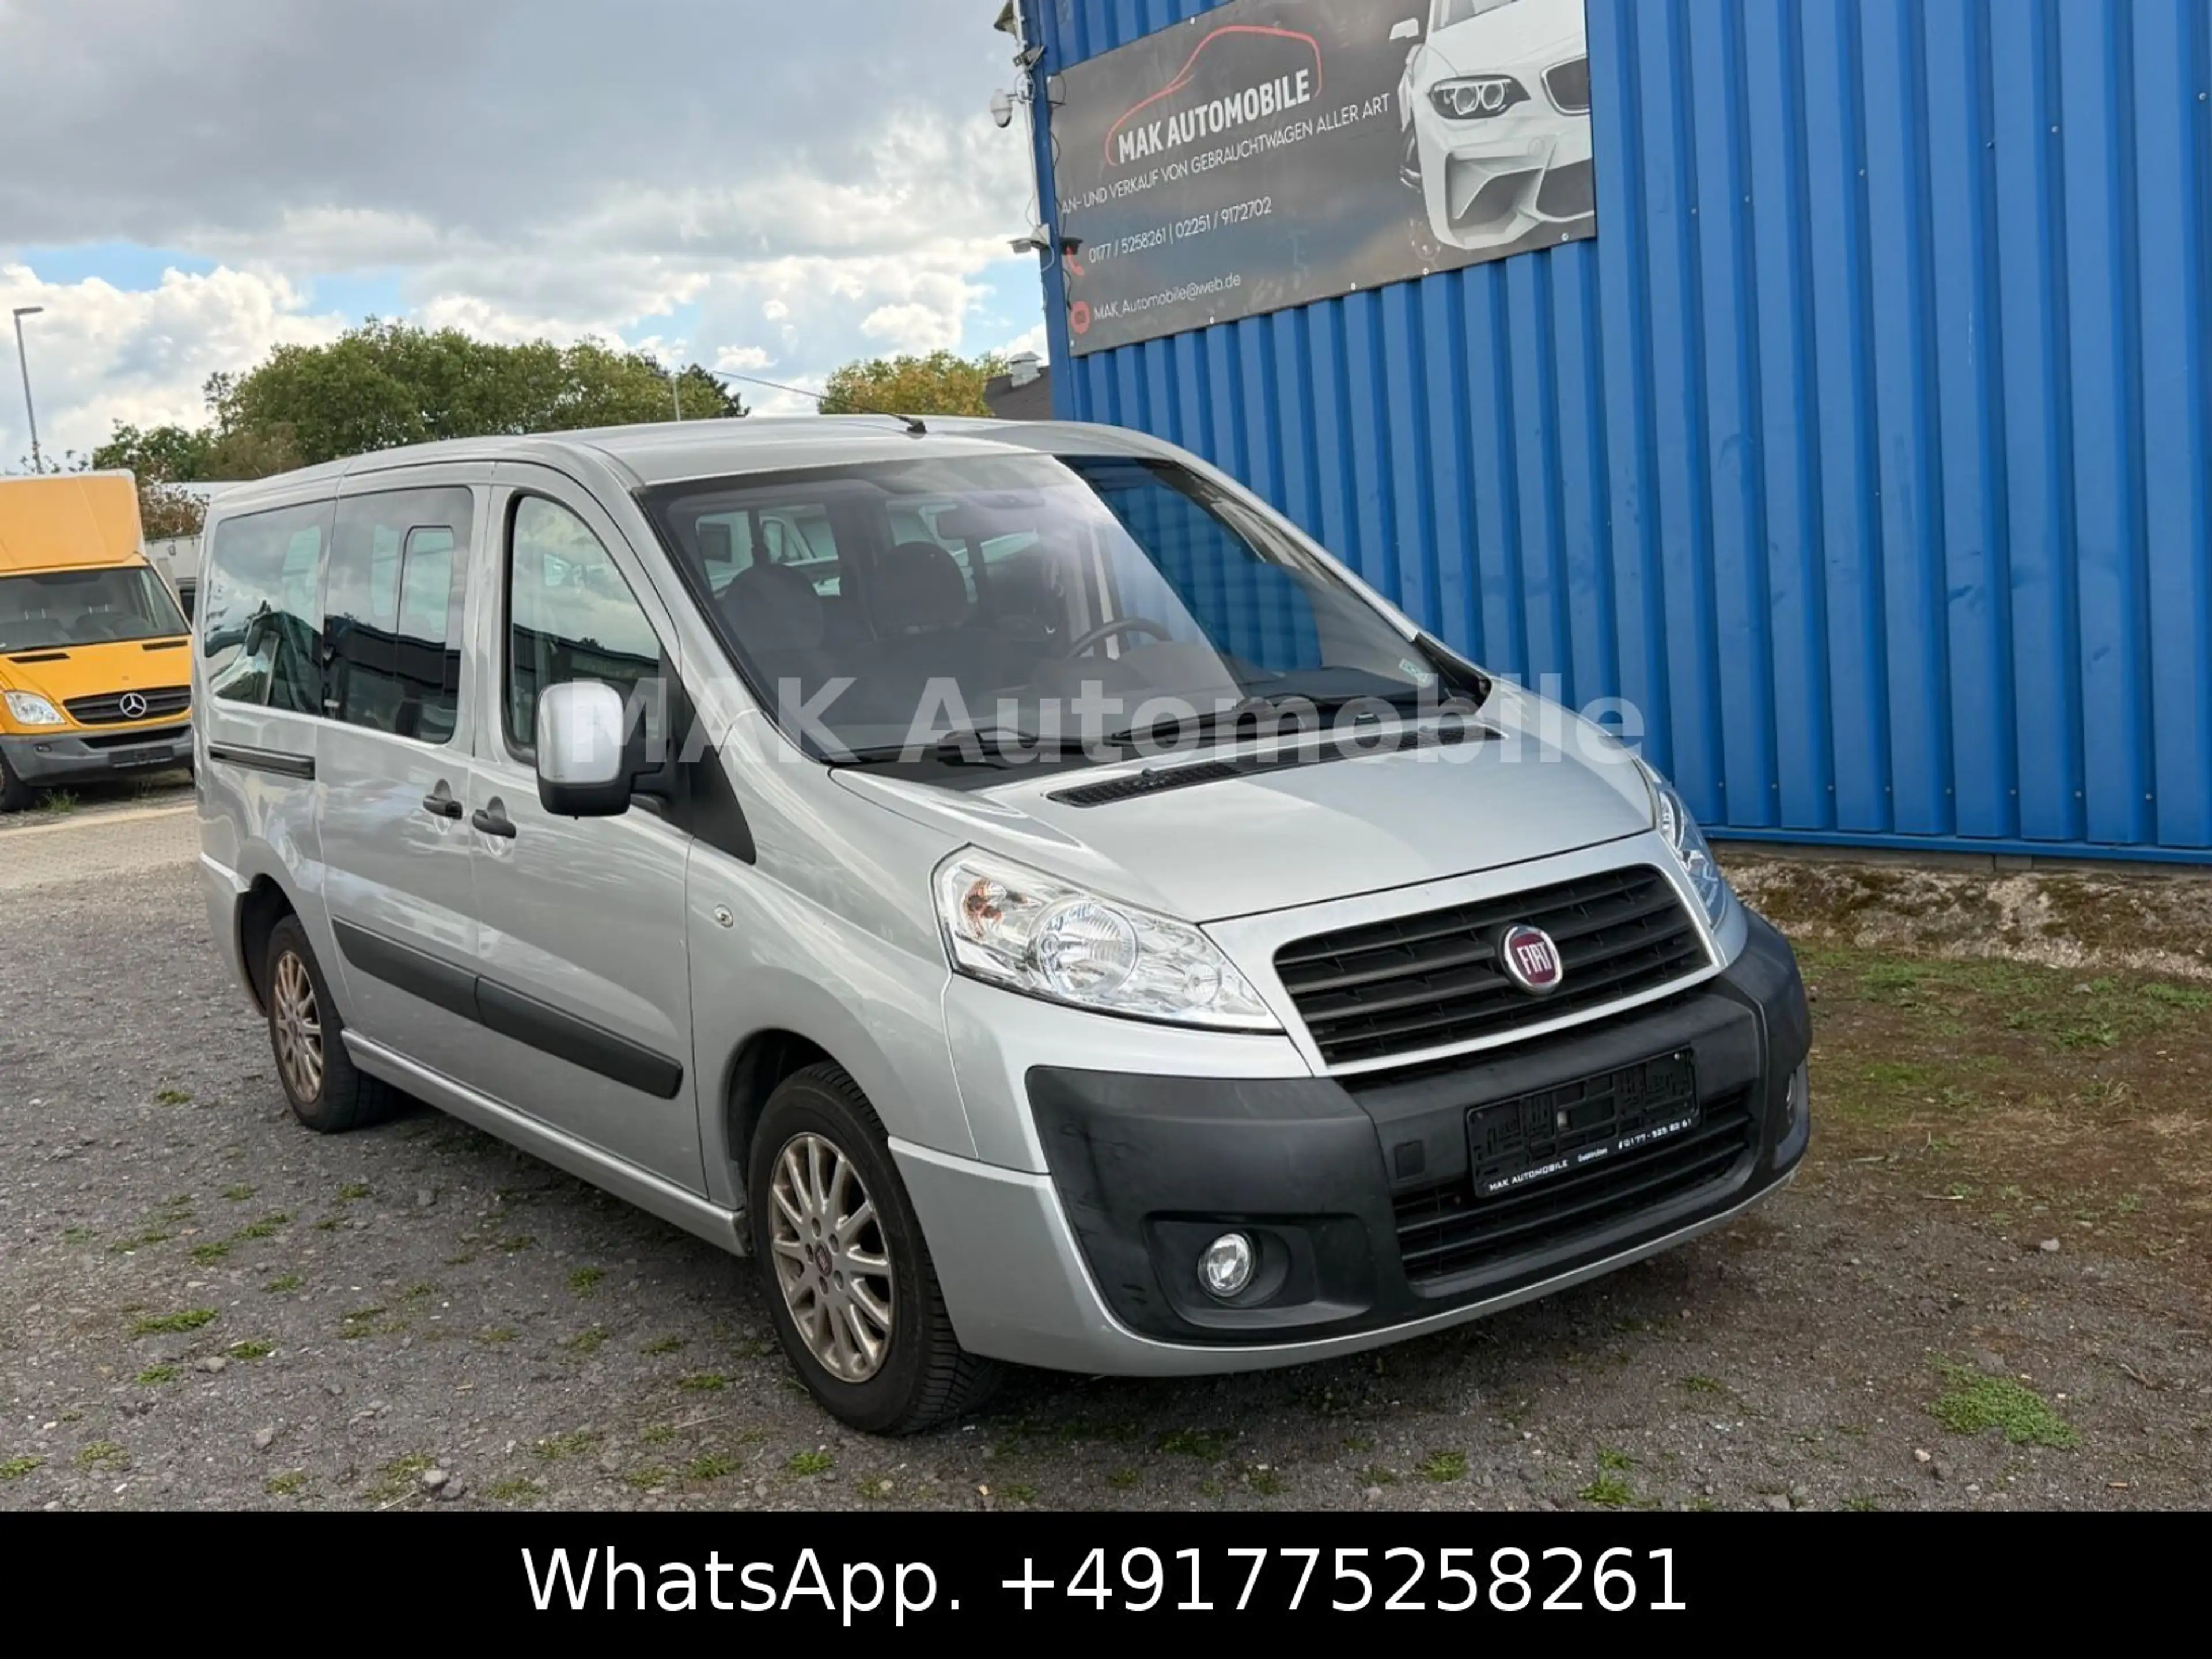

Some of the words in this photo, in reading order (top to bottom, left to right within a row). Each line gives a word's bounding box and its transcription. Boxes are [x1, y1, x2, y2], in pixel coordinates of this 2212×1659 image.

[1083, 187, 1107, 208] UND
[1109, 168, 1158, 198] VERKAUF
[1161, 160, 1189, 182] VON
[1191, 118, 1313, 173] GEBRAUCHTWAGEN
[1316, 104, 1359, 134] ALLER
[1361, 92, 1391, 119] ART
[1118, 120, 1164, 164] MAK
[1167, 69, 1310, 148] AUTOMOBILE
[1089, 243, 1112, 263] 0177
[1121, 227, 1167, 254] 5258261
[1175, 214, 1210, 238] 02251
[1221, 197, 1272, 226] 9172702
[1516, 941, 1552, 975] FIAT
